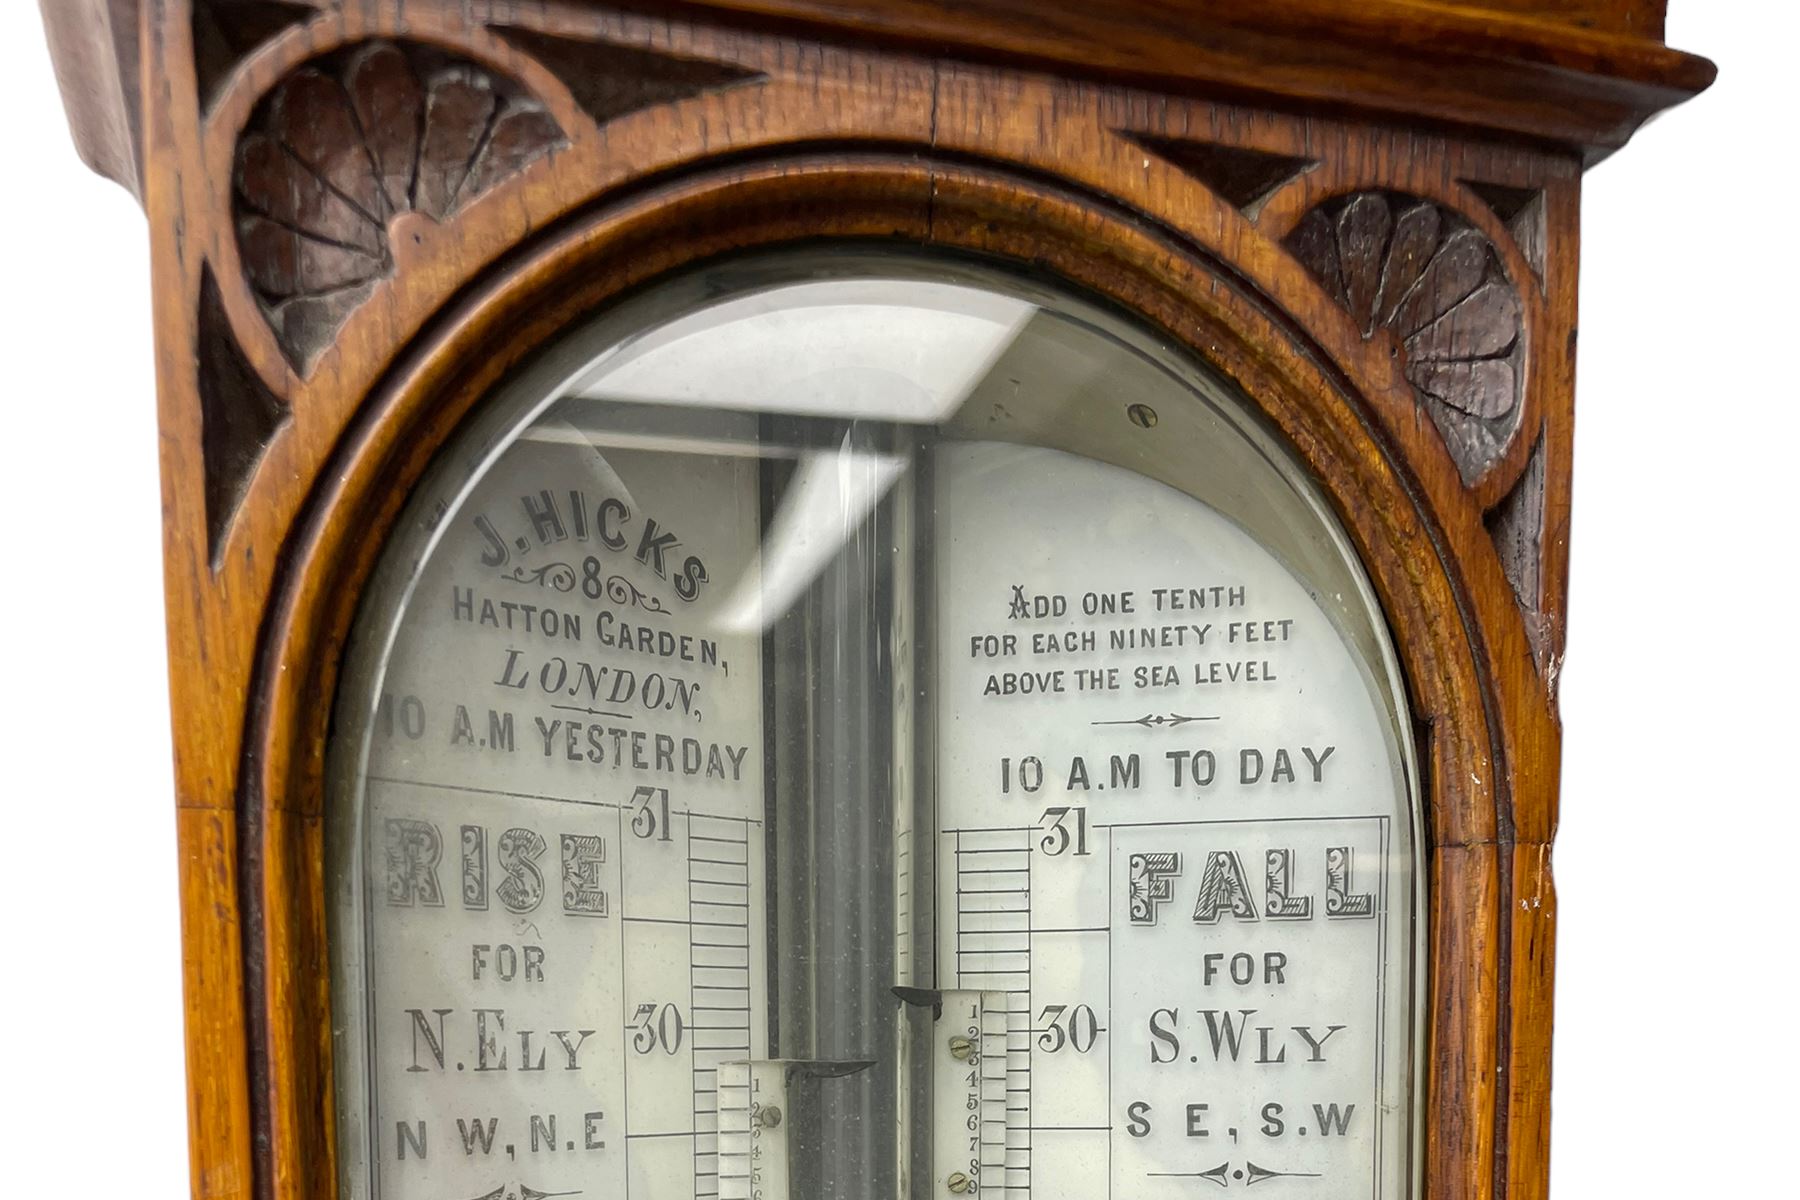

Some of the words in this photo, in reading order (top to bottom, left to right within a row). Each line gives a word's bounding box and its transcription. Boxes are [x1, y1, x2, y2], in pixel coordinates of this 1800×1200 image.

[473, 489, 709, 602] J.HICKS
[582, 556, 602, 600] 8
[1008, 585, 1067, 619] ADD
[1082, 592, 1135, 616] ONE
[1152, 586, 1246, 611] TENTH
[453, 585, 581, 640] HATTON
[596, 611, 728, 677] GARDEN,
[970, 634, 1017, 657] FOR
[1033, 630, 1096, 654] EACH
[1110, 624, 1211, 650] NINETY
[1228, 620, 1293, 643] FEET
[494, 648, 702, 722] LONDON,
[984, 671, 1065, 696] ABOVE
[1074, 668, 1120, 691] THE
[1134, 666, 1180, 688] SEA
[1195, 661, 1277, 684] LEVEL
[378, 694, 426, 740] 10
[450, 704, 515, 752] A.M
[535, 716, 748, 780] YESTERDAY
[1001, 756, 1044, 794] 10
[1067, 754, 1140, 791] A.M
[1166, 750, 1216, 787] TO
[1239, 746, 1335, 785] DAY
[631, 785, 673, 842] 31
[1038, 807, 1091, 857] 31
[385, 817, 609, 918] RISE
[1129, 846, 1376, 926] FALL
[472, 944, 545, 982] FOR
[1203, 952, 1288, 986] FOR
[632, 1003, 683, 1055] 30
[970, 1005, 978, 1019] 1
[1038, 1004, 1097, 1054] 30
[967, 1026, 979, 1042] 2
[968, 1051, 980, 1066] 3
[753, 1078, 760, 1093] 1
[966, 1071, 978, 1087] 4
[752, 1102, 760, 1118] 2
[967, 1094, 978, 1111] 5
[967, 1115, 978, 1130] 6
[753, 1145, 762, 1161] 4
[969, 1137, 979, 1151] 7
[752, 1168, 762, 1185] 5
[969, 1159, 979, 1175] 8
[967, 1180, 978, 1195] 9
